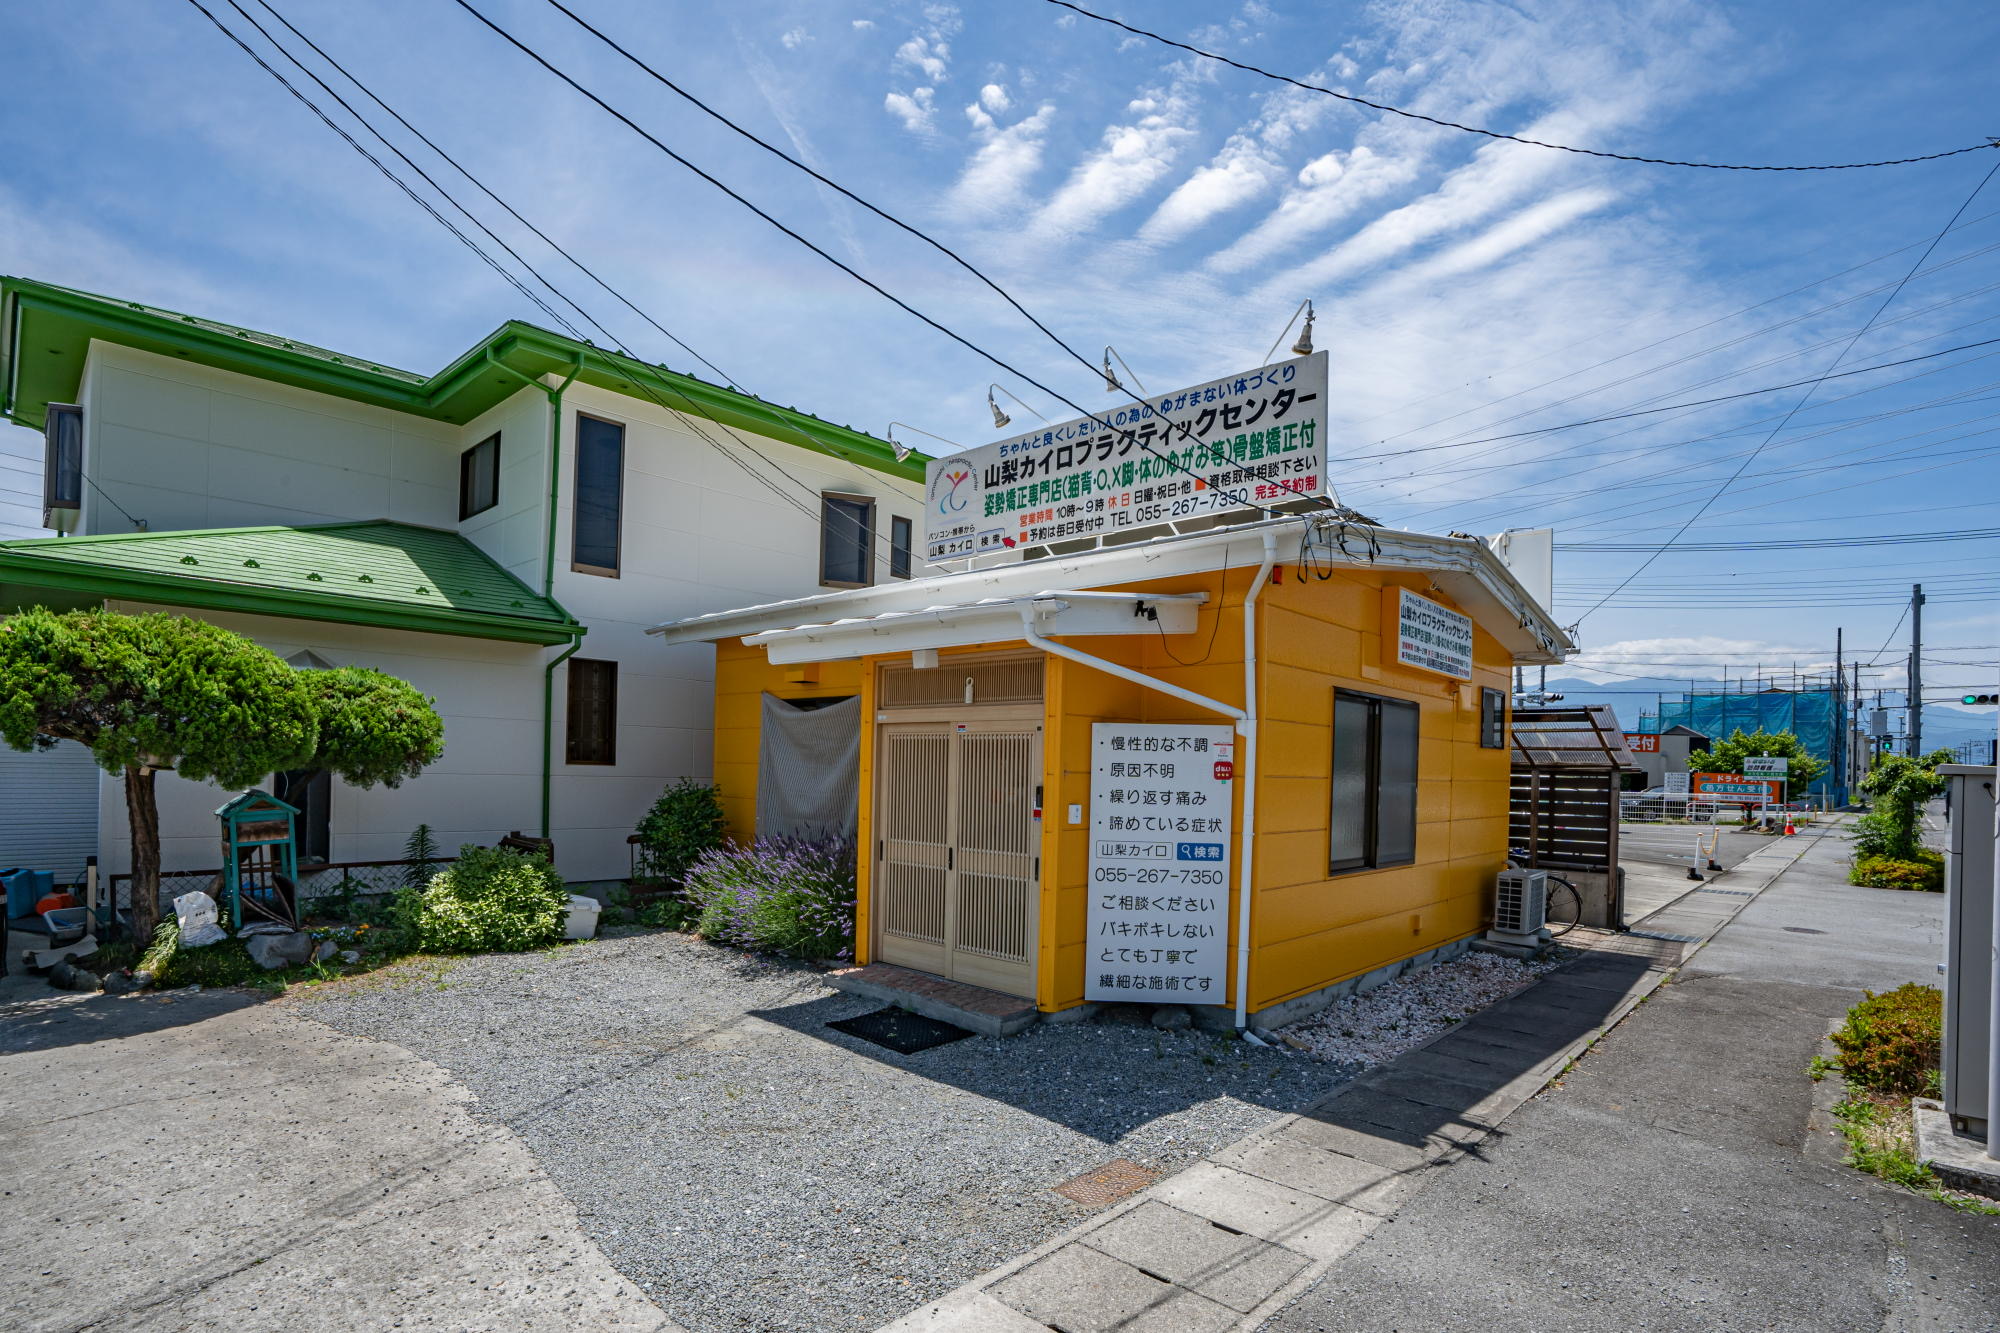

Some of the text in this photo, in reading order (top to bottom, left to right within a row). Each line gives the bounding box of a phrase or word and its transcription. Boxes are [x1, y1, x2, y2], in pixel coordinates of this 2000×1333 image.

[1161, 365, 1296, 414] ゆがまない体づくり
[985, 388, 1317, 489] 山梨カイロプラクティックセンター
[1020, 508, 1053, 527] 営業時間
[1209, 455, 1318, 489] 資格取得相談下さい
[1030, 475, 1317, 541] 予約は毎日受付中 TEL 055-267-7350 完全予約制
[949, 539, 973, 553] カイロ
[1627, 736, 1655, 751] 受付
[1110, 762, 1175, 778] 原因不明
[1101, 843, 1220, 859] 山梨カイロ 検索
[1095, 867, 1223, 885] 055-267-7350
[1101, 895, 1215, 912] ご相談ください
[1100, 921, 1214, 938] バキボキしない
[1100, 948, 1198, 964] とても丁寧で
[1099, 974, 1213, 992] 繊細な施術です
